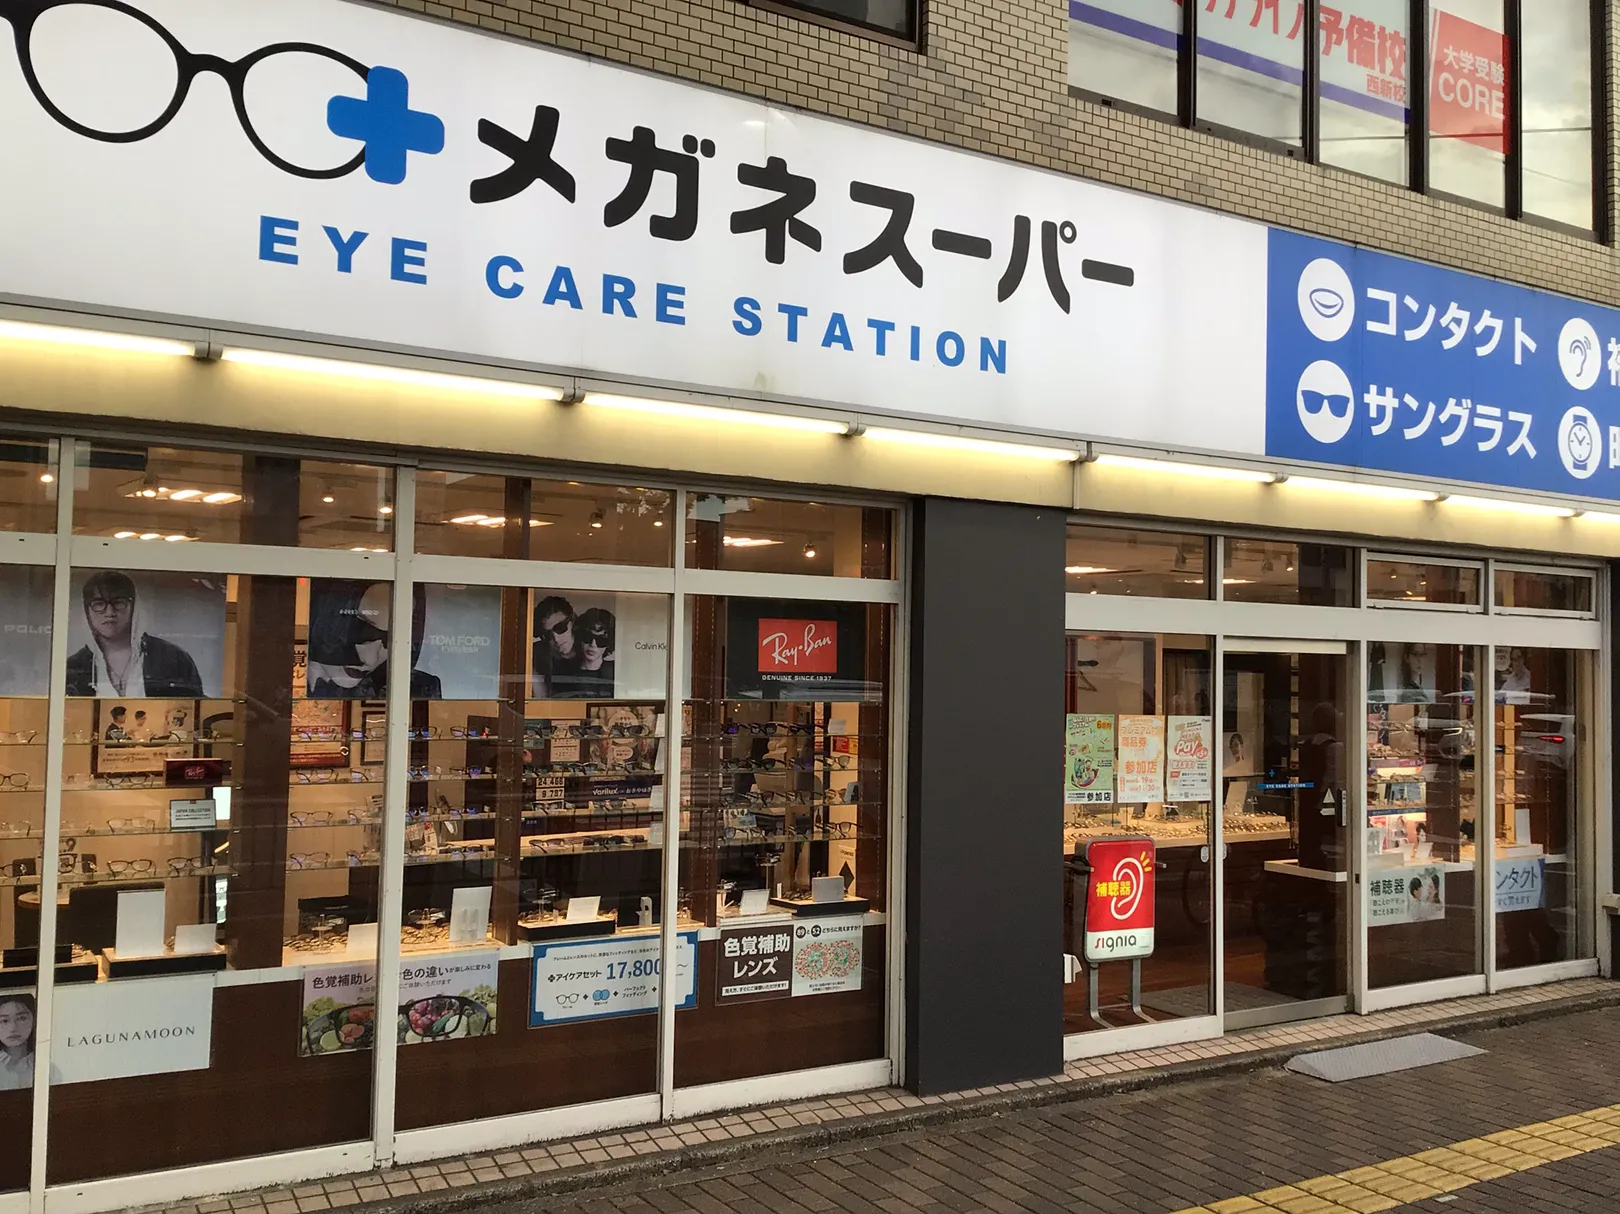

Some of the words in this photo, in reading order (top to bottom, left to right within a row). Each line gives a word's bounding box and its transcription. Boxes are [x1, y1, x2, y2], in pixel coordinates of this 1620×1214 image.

[1438, 72, 1505, 119] CORE
[470, 105, 1134, 314] メガネスーパー
[259, 215, 427, 285] EYE
[485, 255, 687, 326] CARE
[732, 296, 1006, 374] STATION
[1366, 287, 1537, 365] コンタクト
[1364, 384, 1537, 459] サングラス
[429, 635, 456, 646] TOM
[458, 636, 490, 646] FORD
[1096, 881, 1131, 897] 補聴器
[1370, 879, 1404, 896] 補聴器
[724, 933, 790, 957] 色覚補助
[1094, 935, 1137, 952] signia
[556, 970, 602, 981] アイケアセット
[733, 956, 779, 979] レンズ
[67, 1026, 196, 1048] LAGUNAMOON
